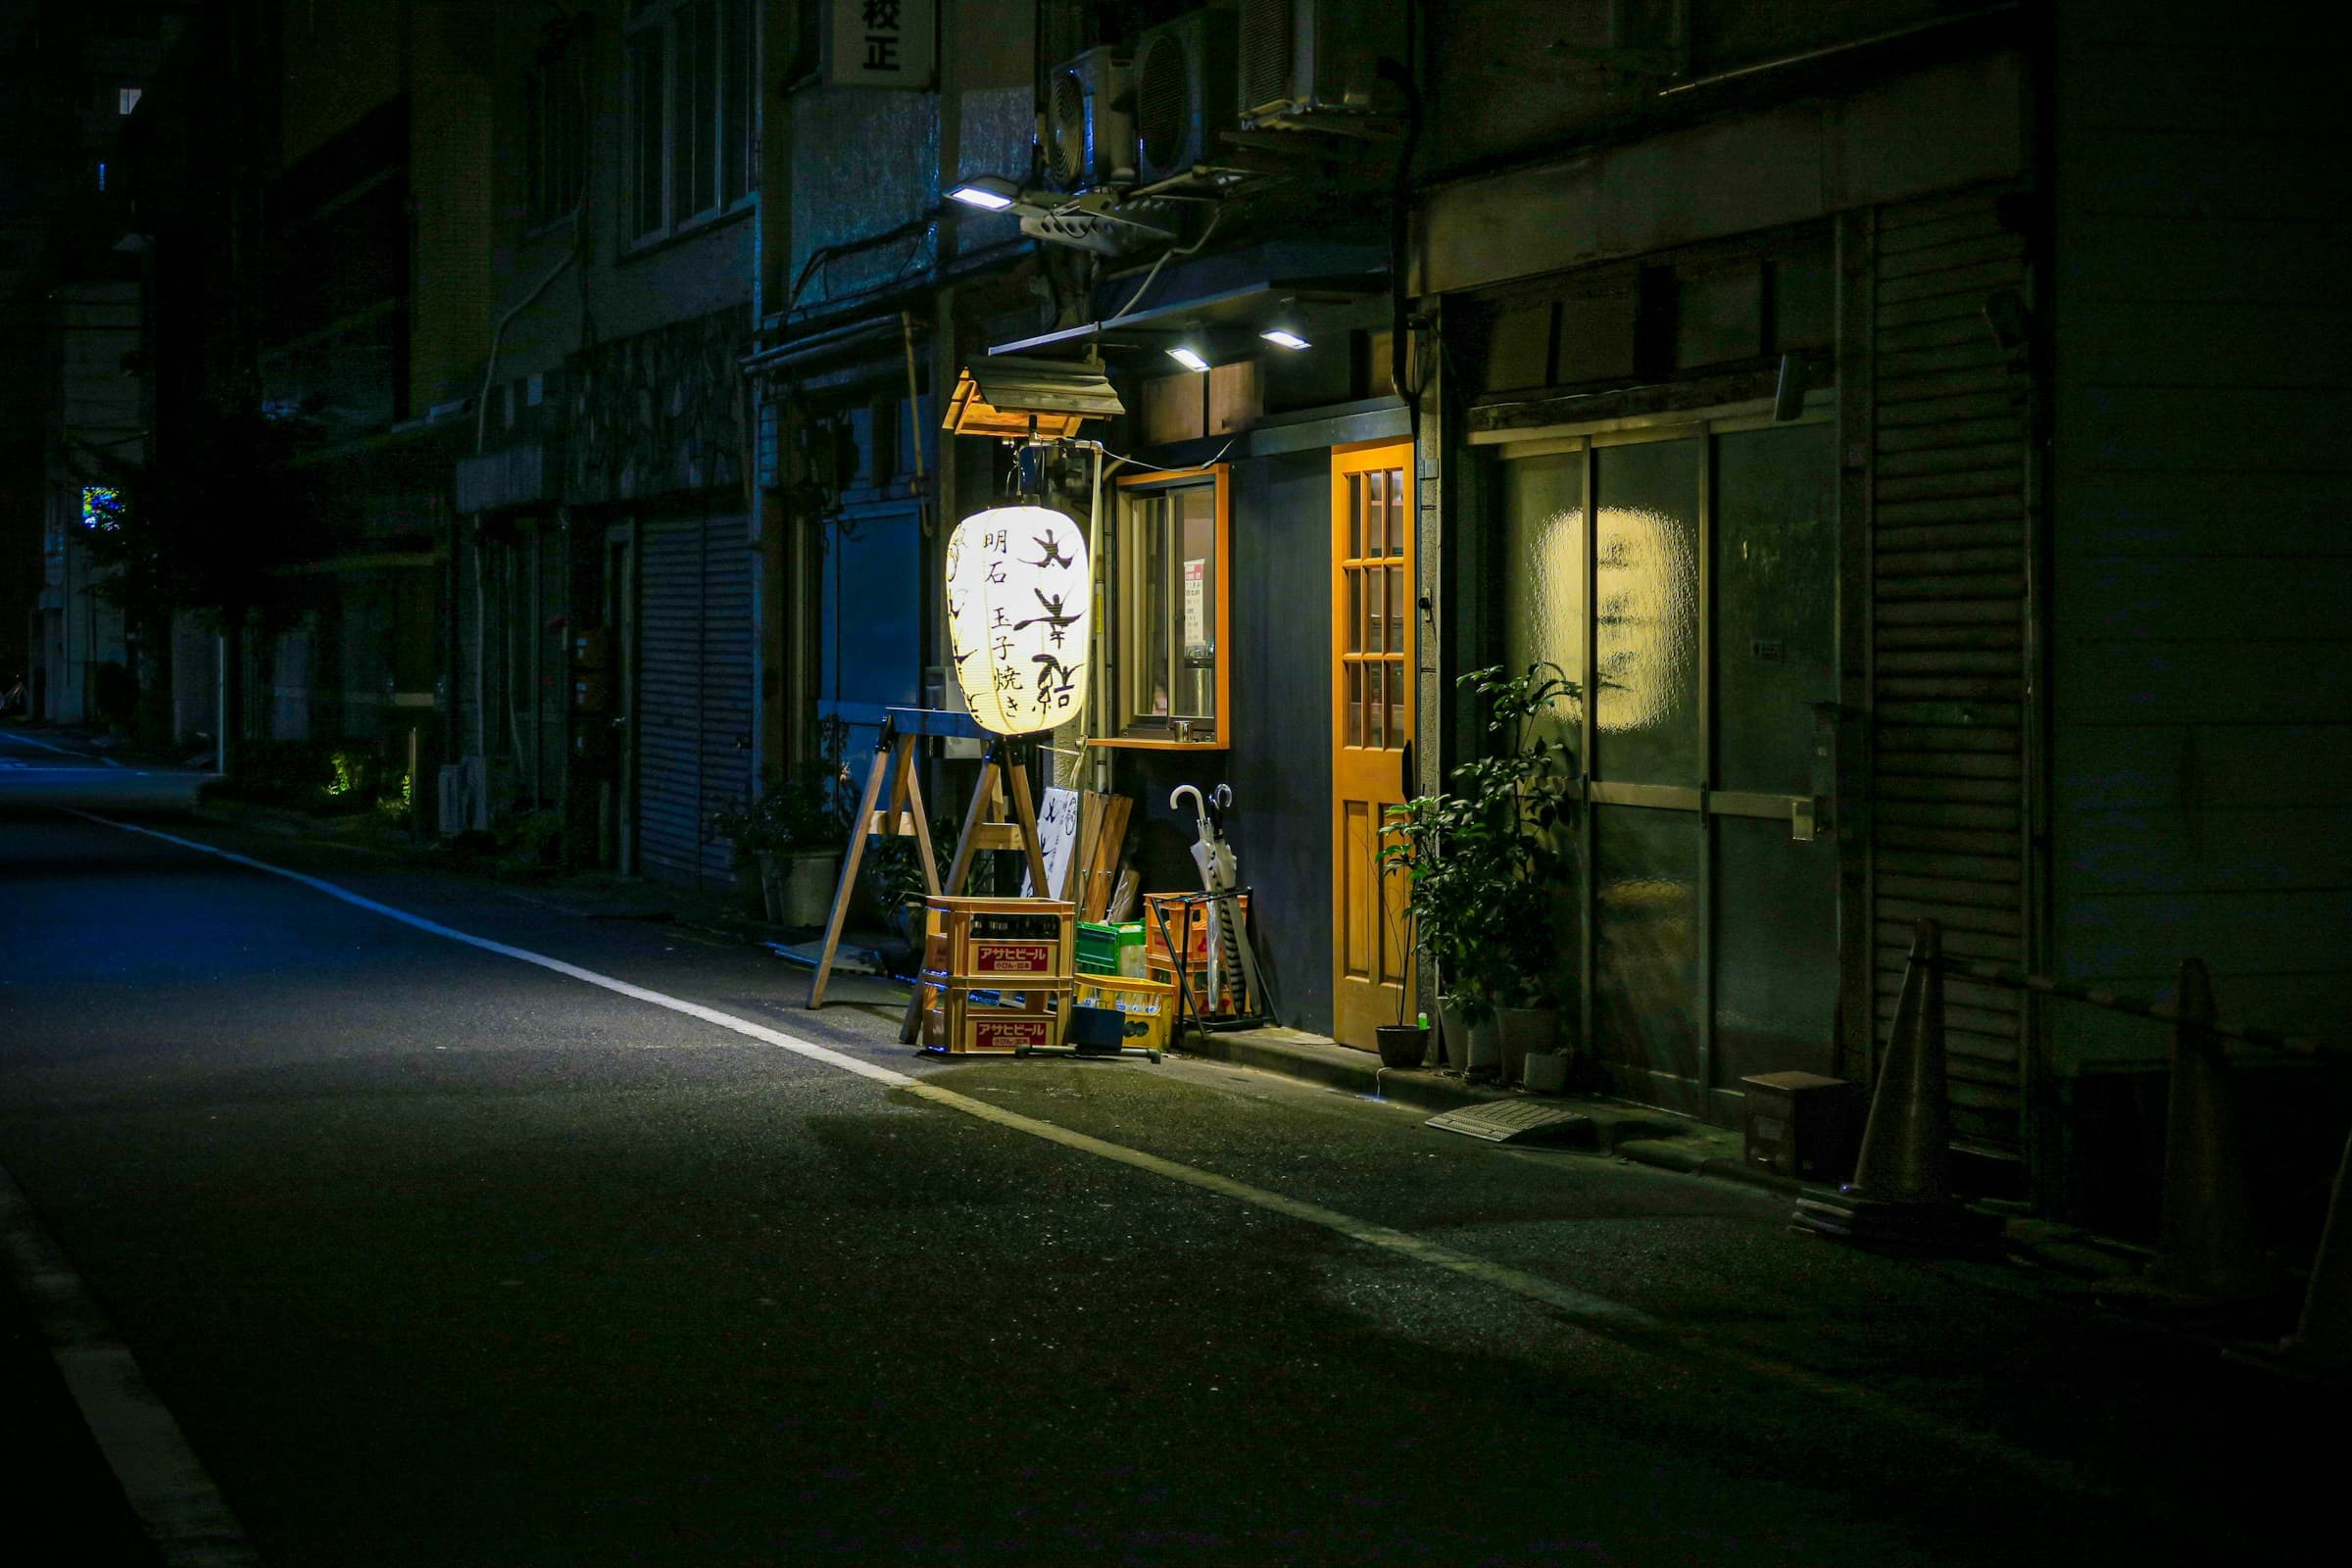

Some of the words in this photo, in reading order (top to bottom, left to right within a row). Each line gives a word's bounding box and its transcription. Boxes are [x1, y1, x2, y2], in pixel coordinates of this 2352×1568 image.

[862, 0, 901, 72] 校正
[983, 529, 1007, 584] 明石
[990, 607, 1024, 717] 玉子焼き
[980, 948, 1047, 960] アサヒビール
[978, 1023, 1045, 1036] アサヒビール
